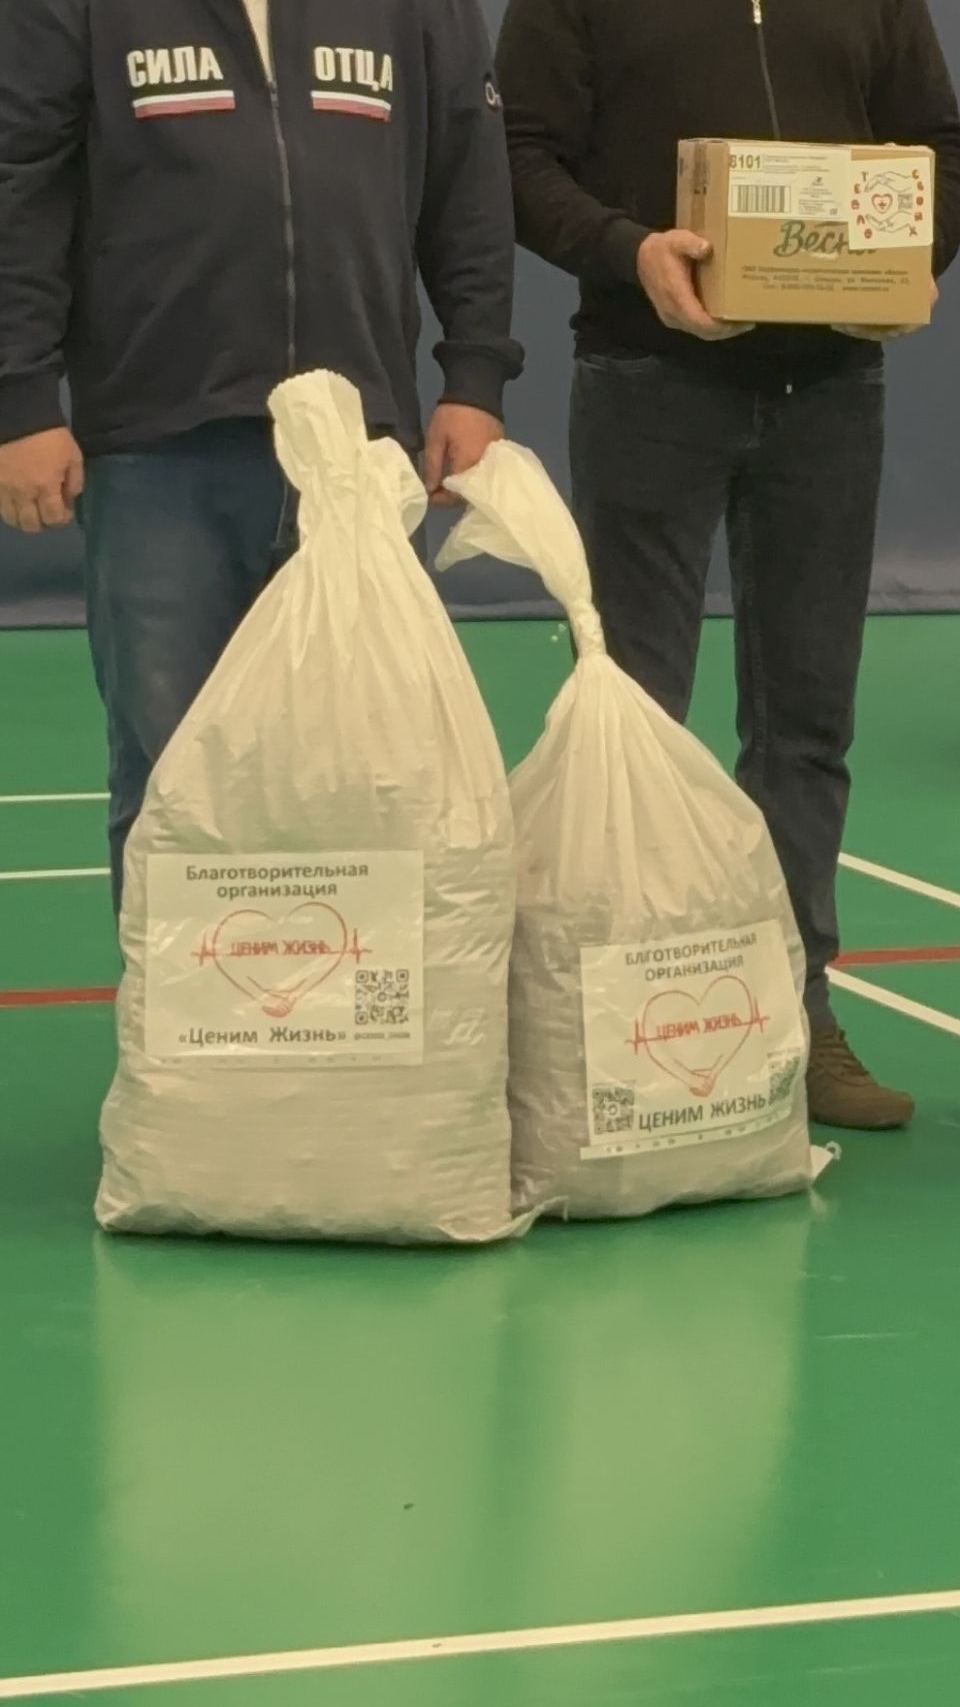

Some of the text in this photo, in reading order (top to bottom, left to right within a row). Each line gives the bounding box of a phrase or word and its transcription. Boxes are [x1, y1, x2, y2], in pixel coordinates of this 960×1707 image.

[127, 46, 394, 92] СИЛА ОТЦА
[185, 864, 369, 882] Благотворительная
[216, 883, 338, 901] организация
[645, 954, 744, 982] ОРГАНИЗАЦИЯ
[178, 1027, 258, 1047] «Ценим
[269, 1026, 347, 1042] Жизнь»
[638, 1094, 766, 1132] ЦЕНИМ ЖИЗНЬ
